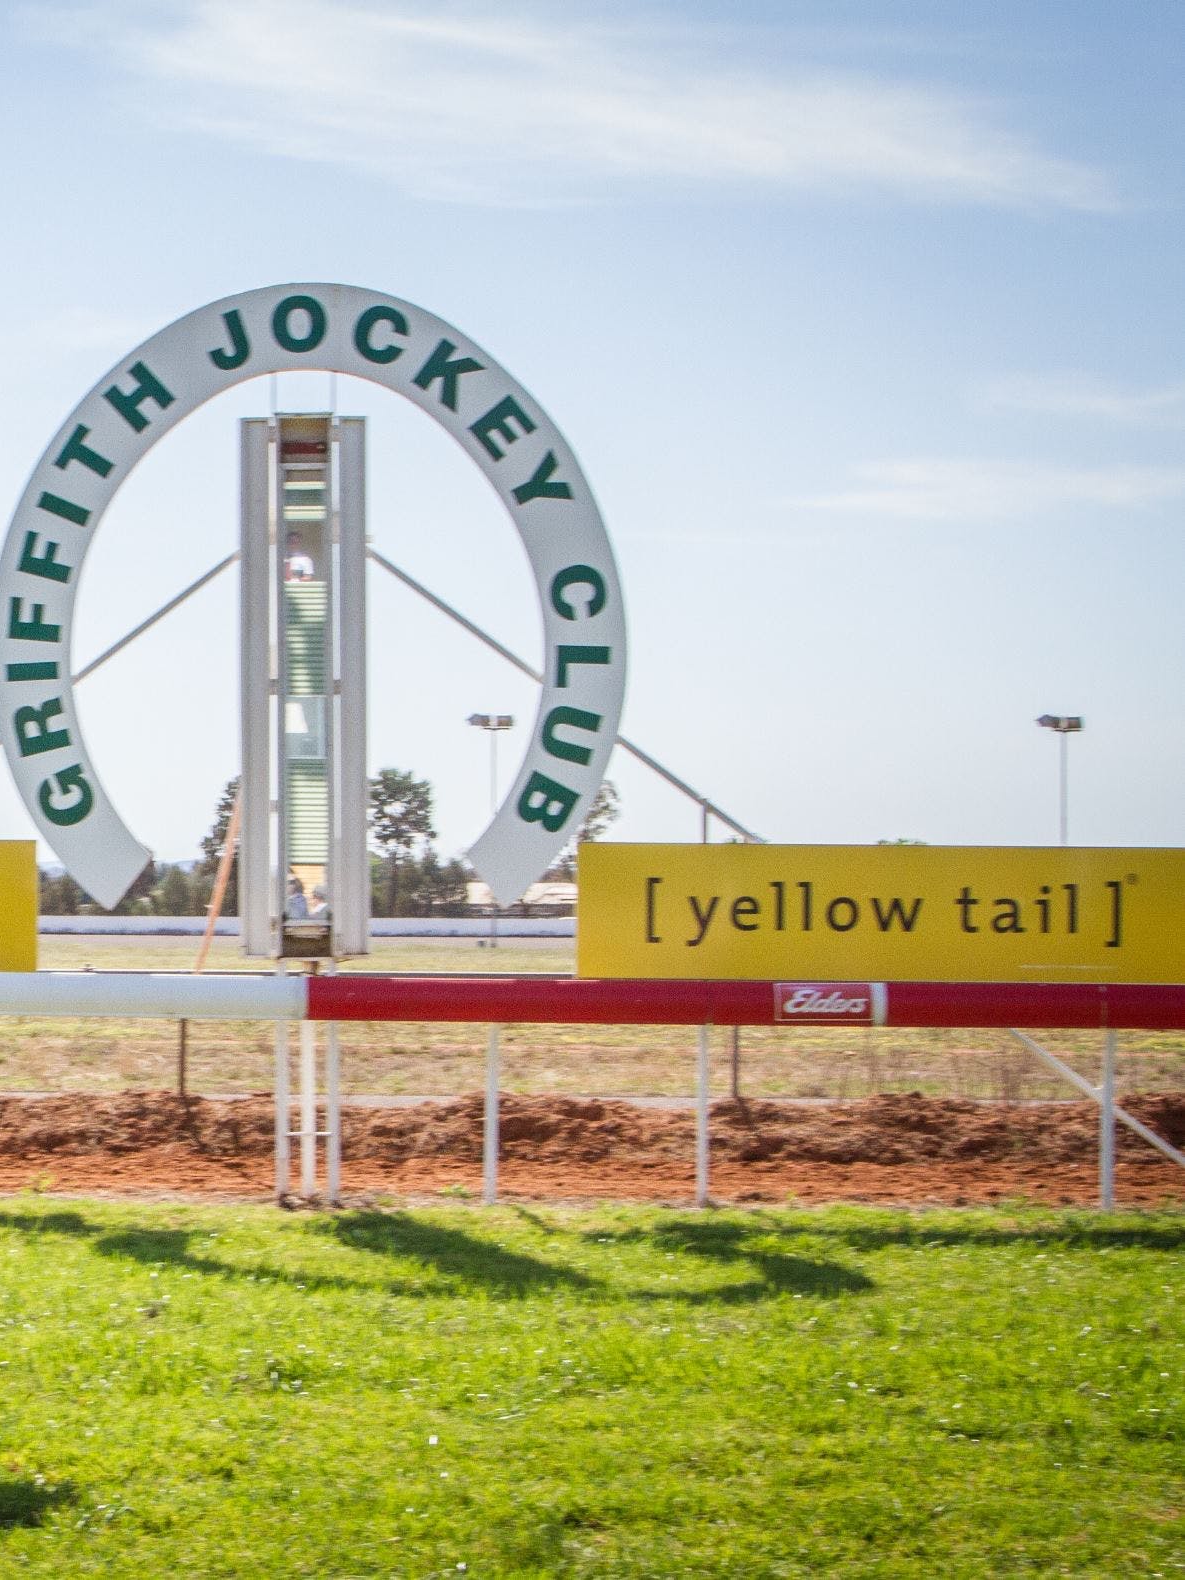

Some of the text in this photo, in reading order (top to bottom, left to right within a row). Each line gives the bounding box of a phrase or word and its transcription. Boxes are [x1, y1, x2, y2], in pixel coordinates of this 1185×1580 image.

[6, 294, 611, 833] GRIFFITH JOCKEY CLUB
[685, 881, 924, 947] yellow
[955, 884, 1079, 934] tail
[782, 988, 870, 1014] Elders
